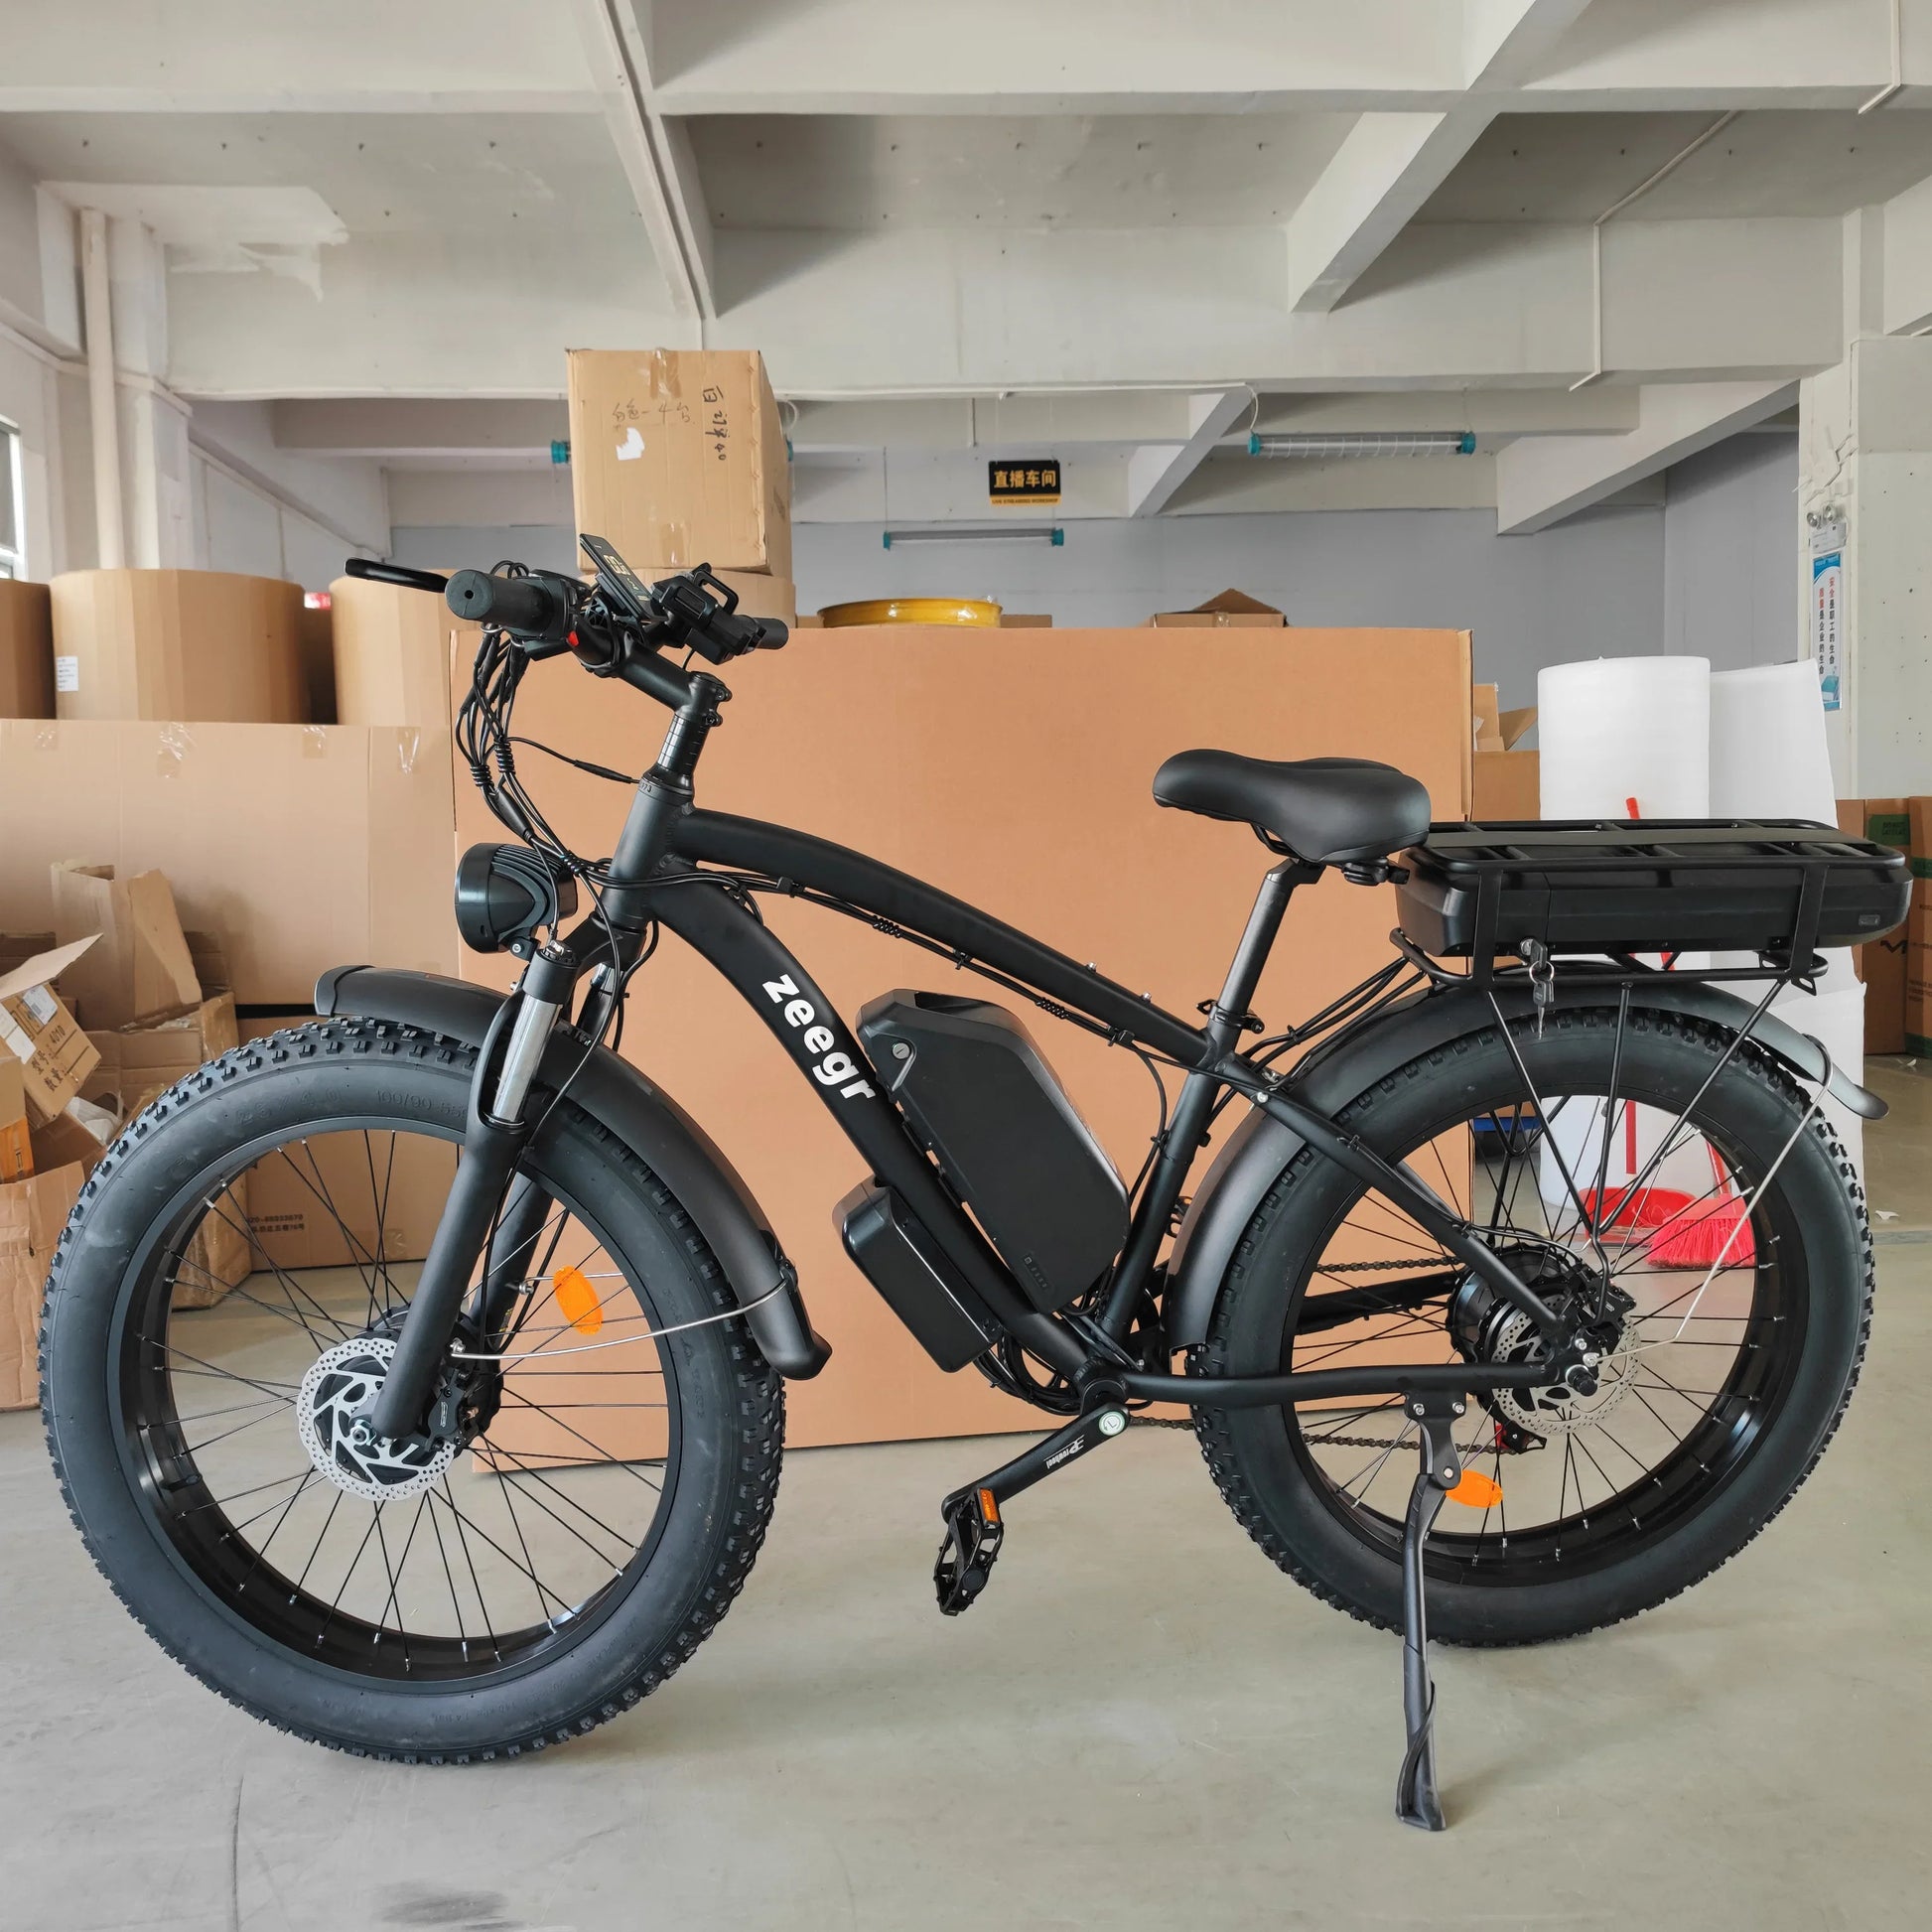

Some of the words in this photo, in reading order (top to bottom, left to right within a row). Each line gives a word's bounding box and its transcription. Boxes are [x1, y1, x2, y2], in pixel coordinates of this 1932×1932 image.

[994, 470, 1056, 488] 直播车间
[761, 973, 877, 1099] zeegr
